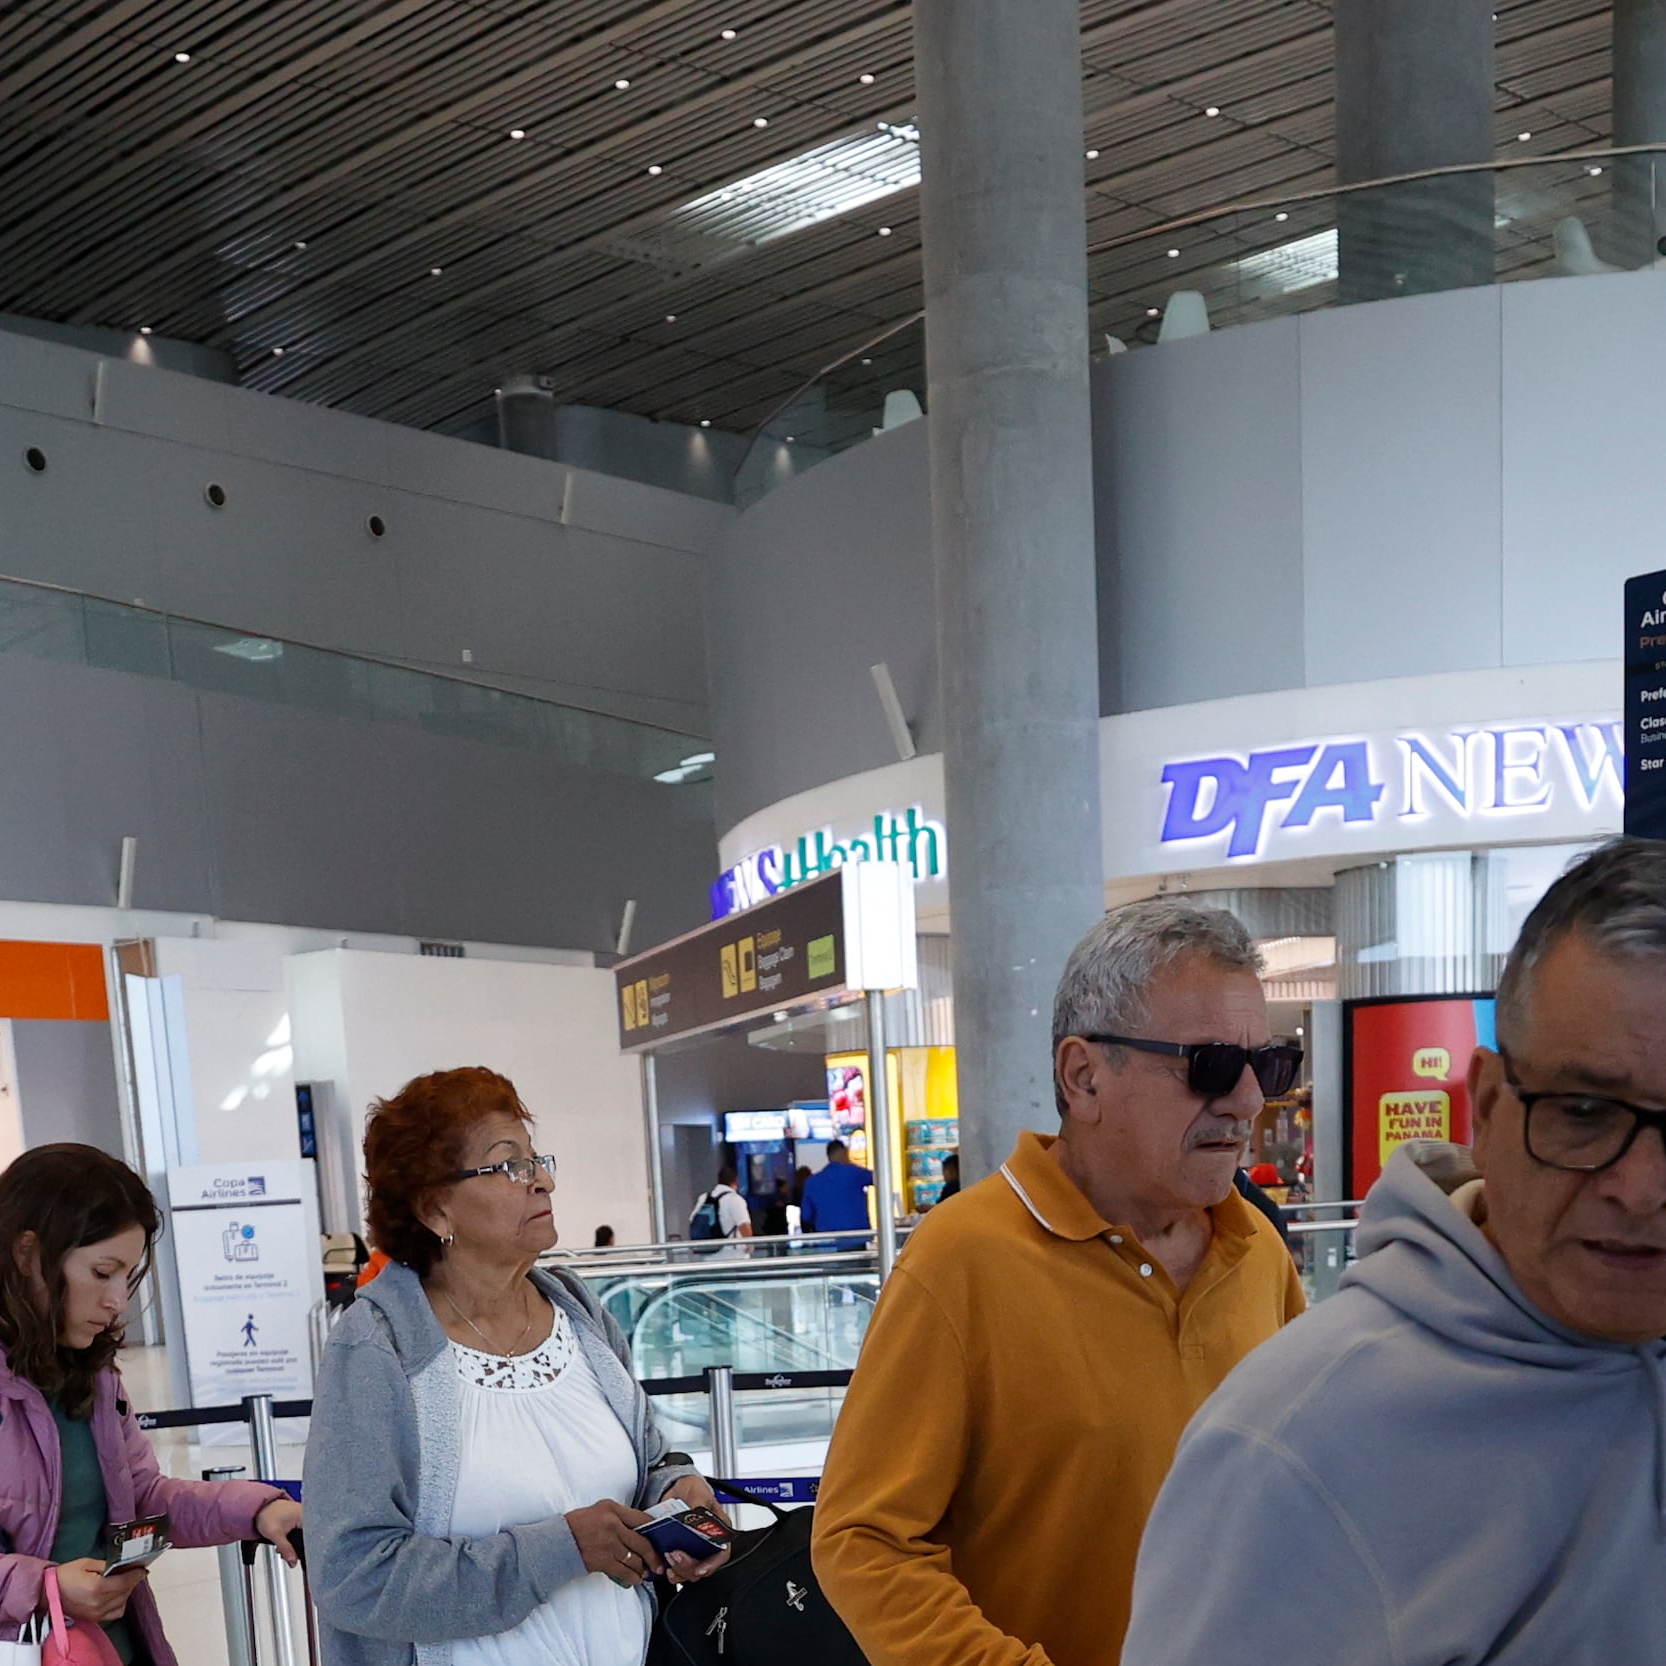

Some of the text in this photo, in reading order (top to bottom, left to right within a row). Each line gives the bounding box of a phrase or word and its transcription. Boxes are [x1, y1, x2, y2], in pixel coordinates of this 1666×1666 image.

[1640, 757, 1665, 771] Star
[1160, 741, 1385, 858] DFA
[1396, 722, 1625, 817] NEW
[1421, 1056, 1443, 1069] HI!
[1385, 1101, 1442, 1116] HAVE
[1389, 1116, 1442, 1130] FUN IN
[1385, 1130, 1443, 1141] PANAMA
[213, 1177, 246, 1191] Copa
[201, 1186, 247, 1199] Airlines
